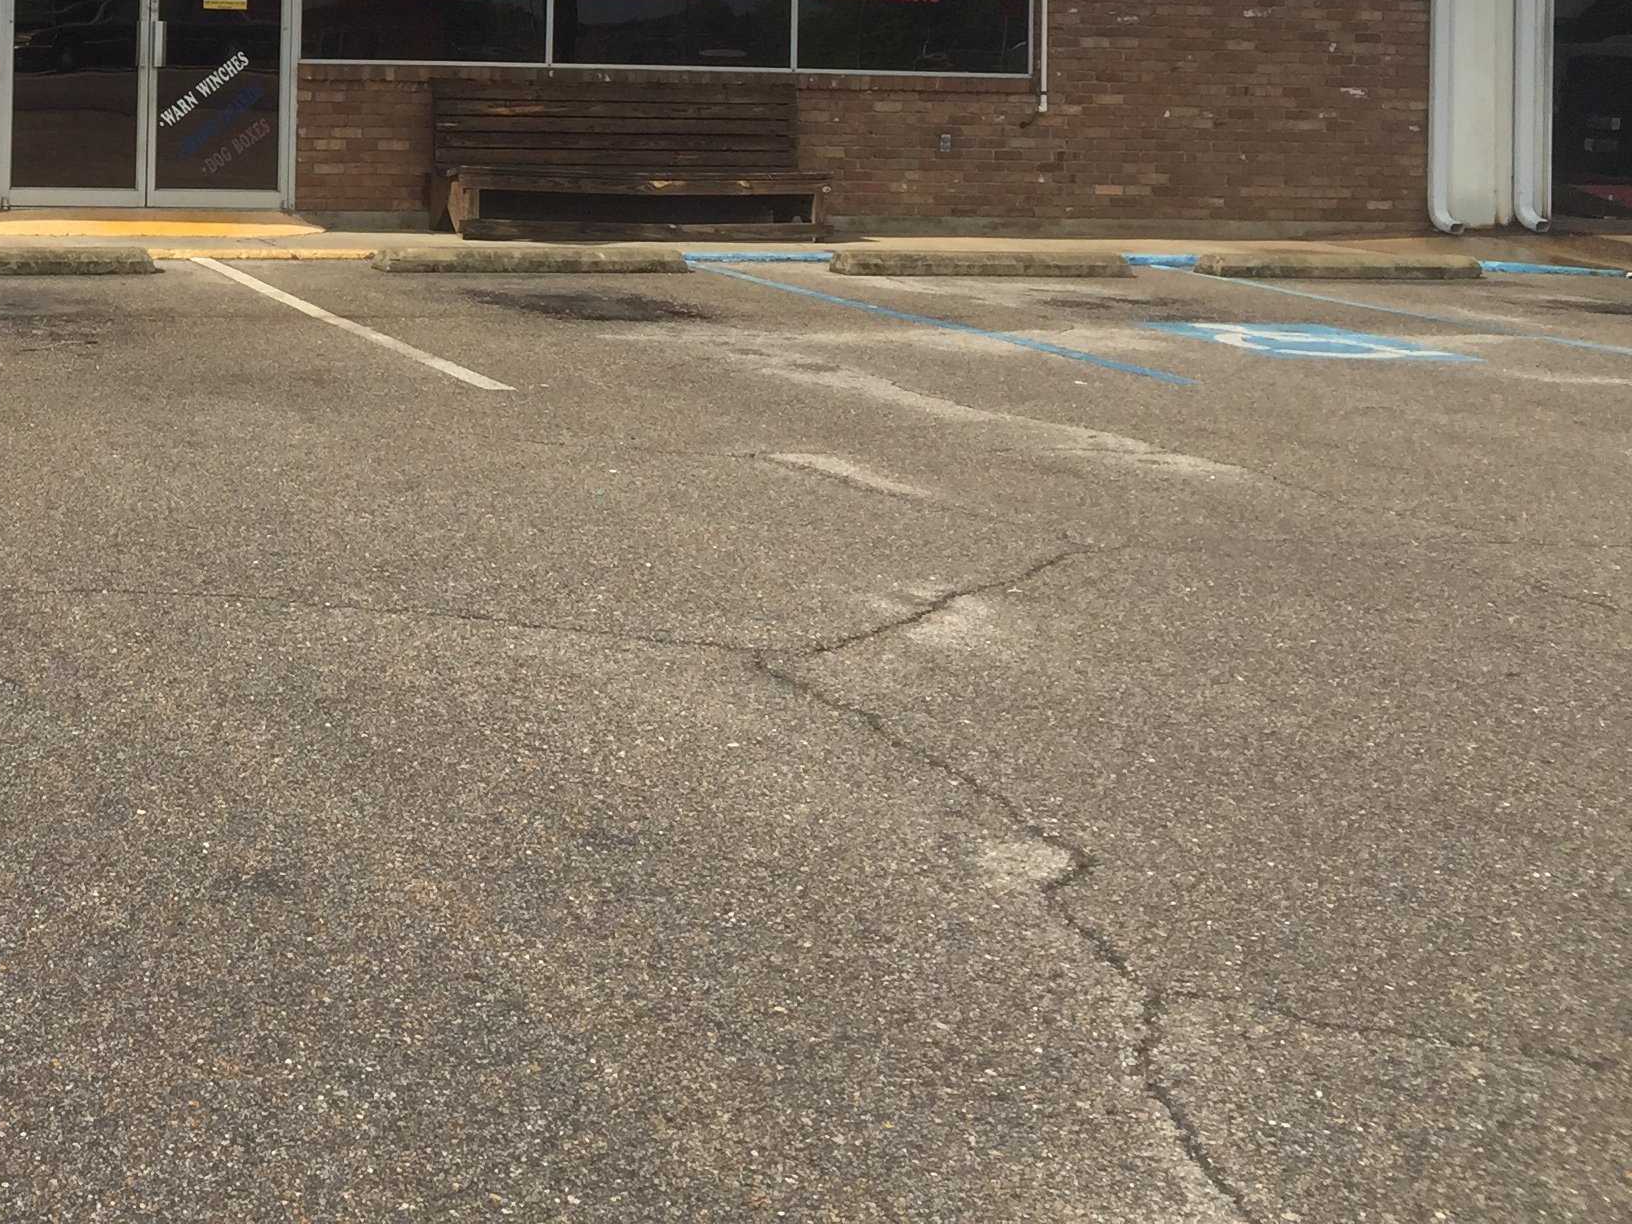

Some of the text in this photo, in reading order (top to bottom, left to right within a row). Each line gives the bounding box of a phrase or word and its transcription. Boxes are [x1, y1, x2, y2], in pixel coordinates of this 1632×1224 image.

[161, 51, 249, 127] WARN WINCHES
[204, 147, 232, 175] DOG
[231, 118, 271, 154] BOXES
